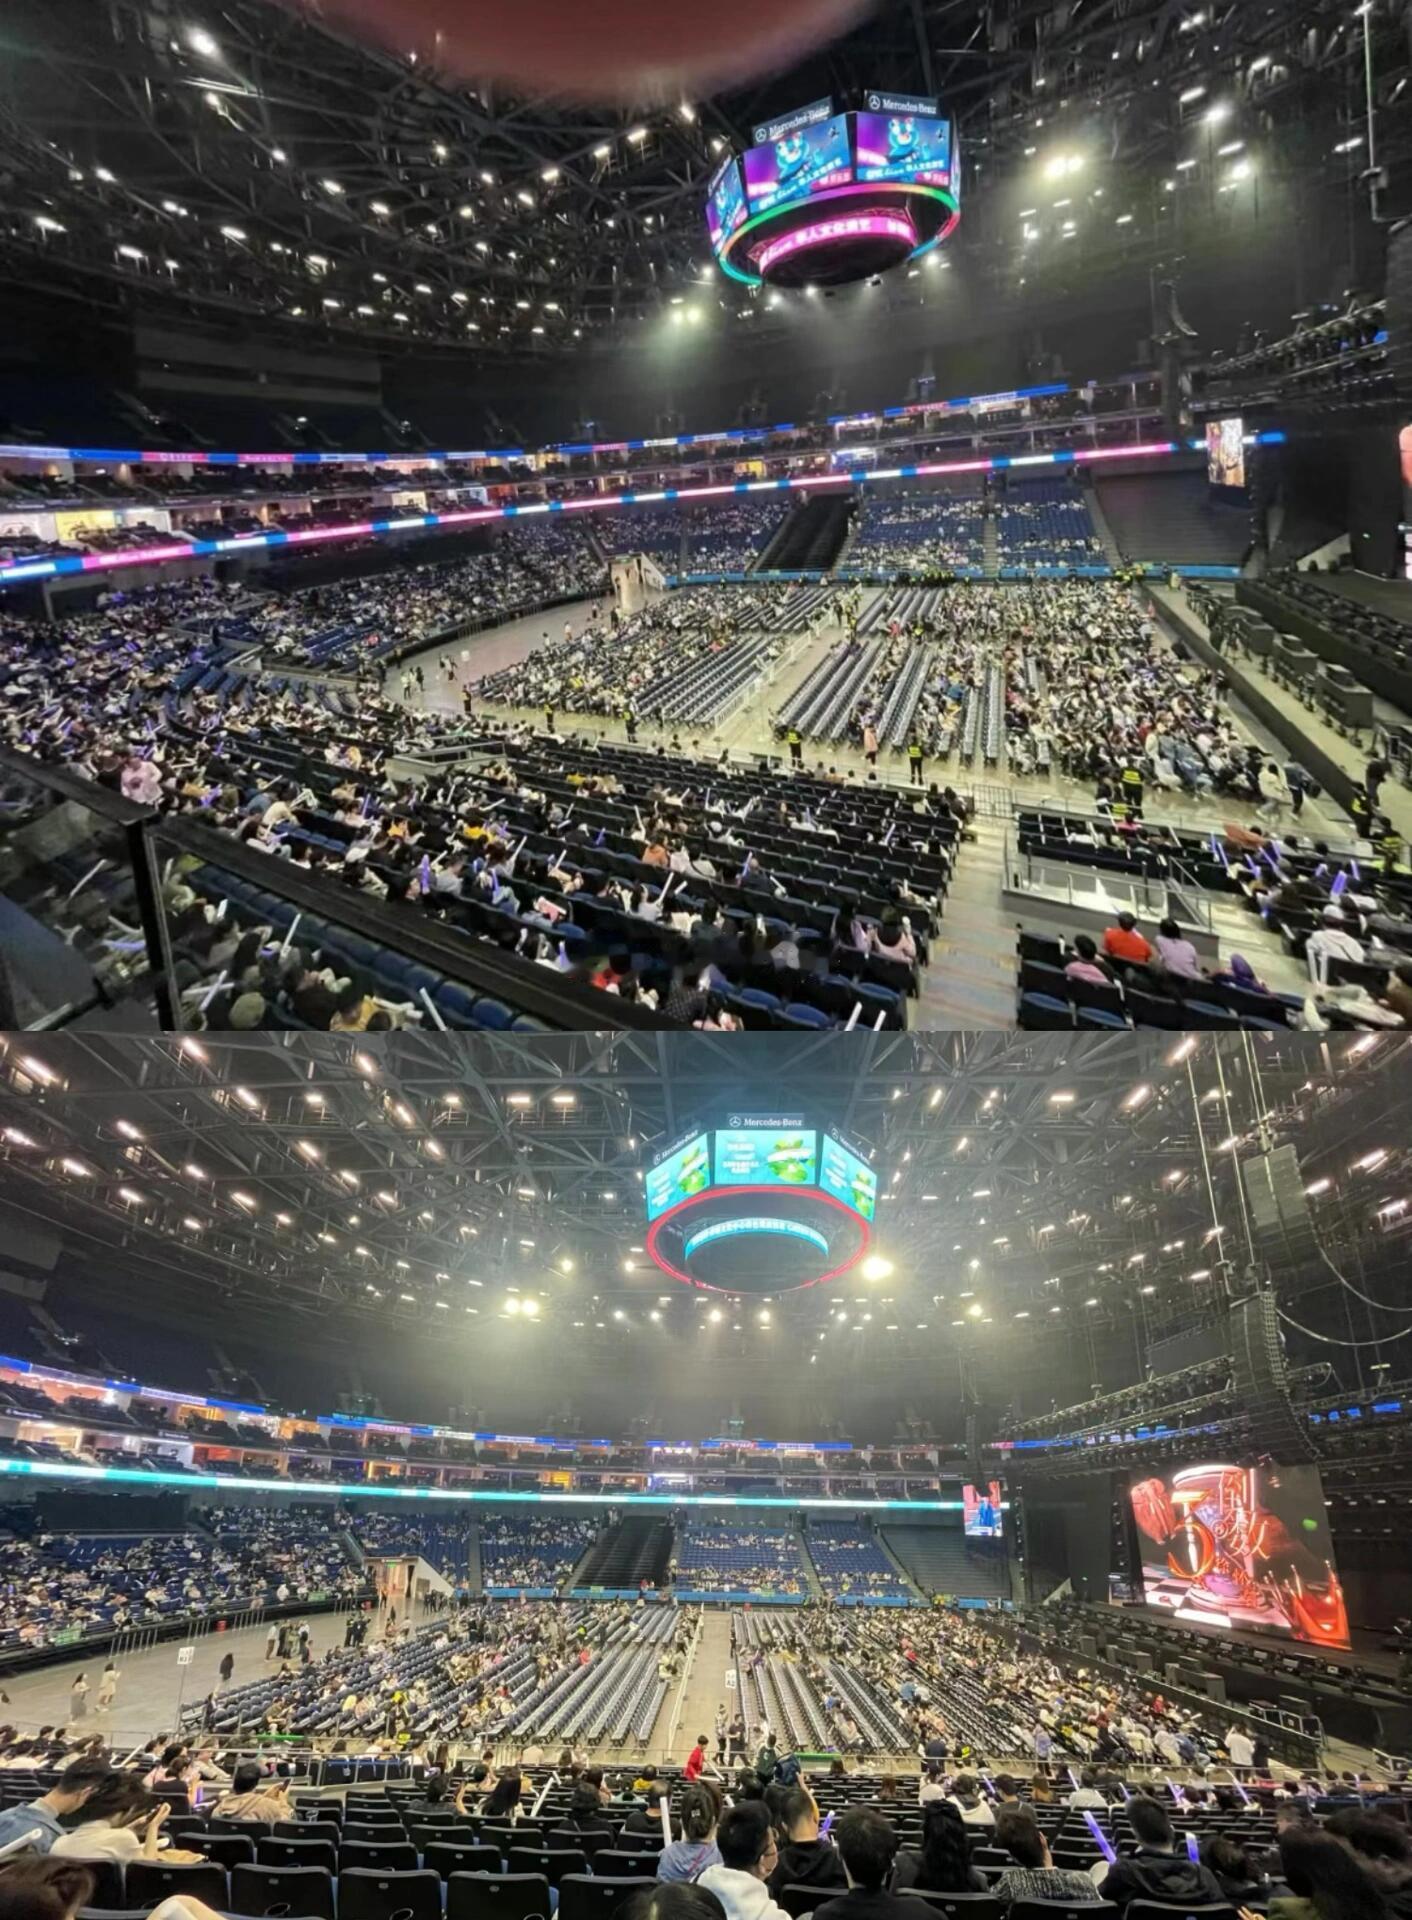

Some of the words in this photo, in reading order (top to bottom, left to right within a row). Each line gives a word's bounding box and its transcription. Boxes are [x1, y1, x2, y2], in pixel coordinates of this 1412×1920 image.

[882, 98, 937, 114] Mercedes-Benz
[768, 105, 831, 136] Mercedes-Benz
[743, 1118, 803, 1127] Mercedes-Benz
